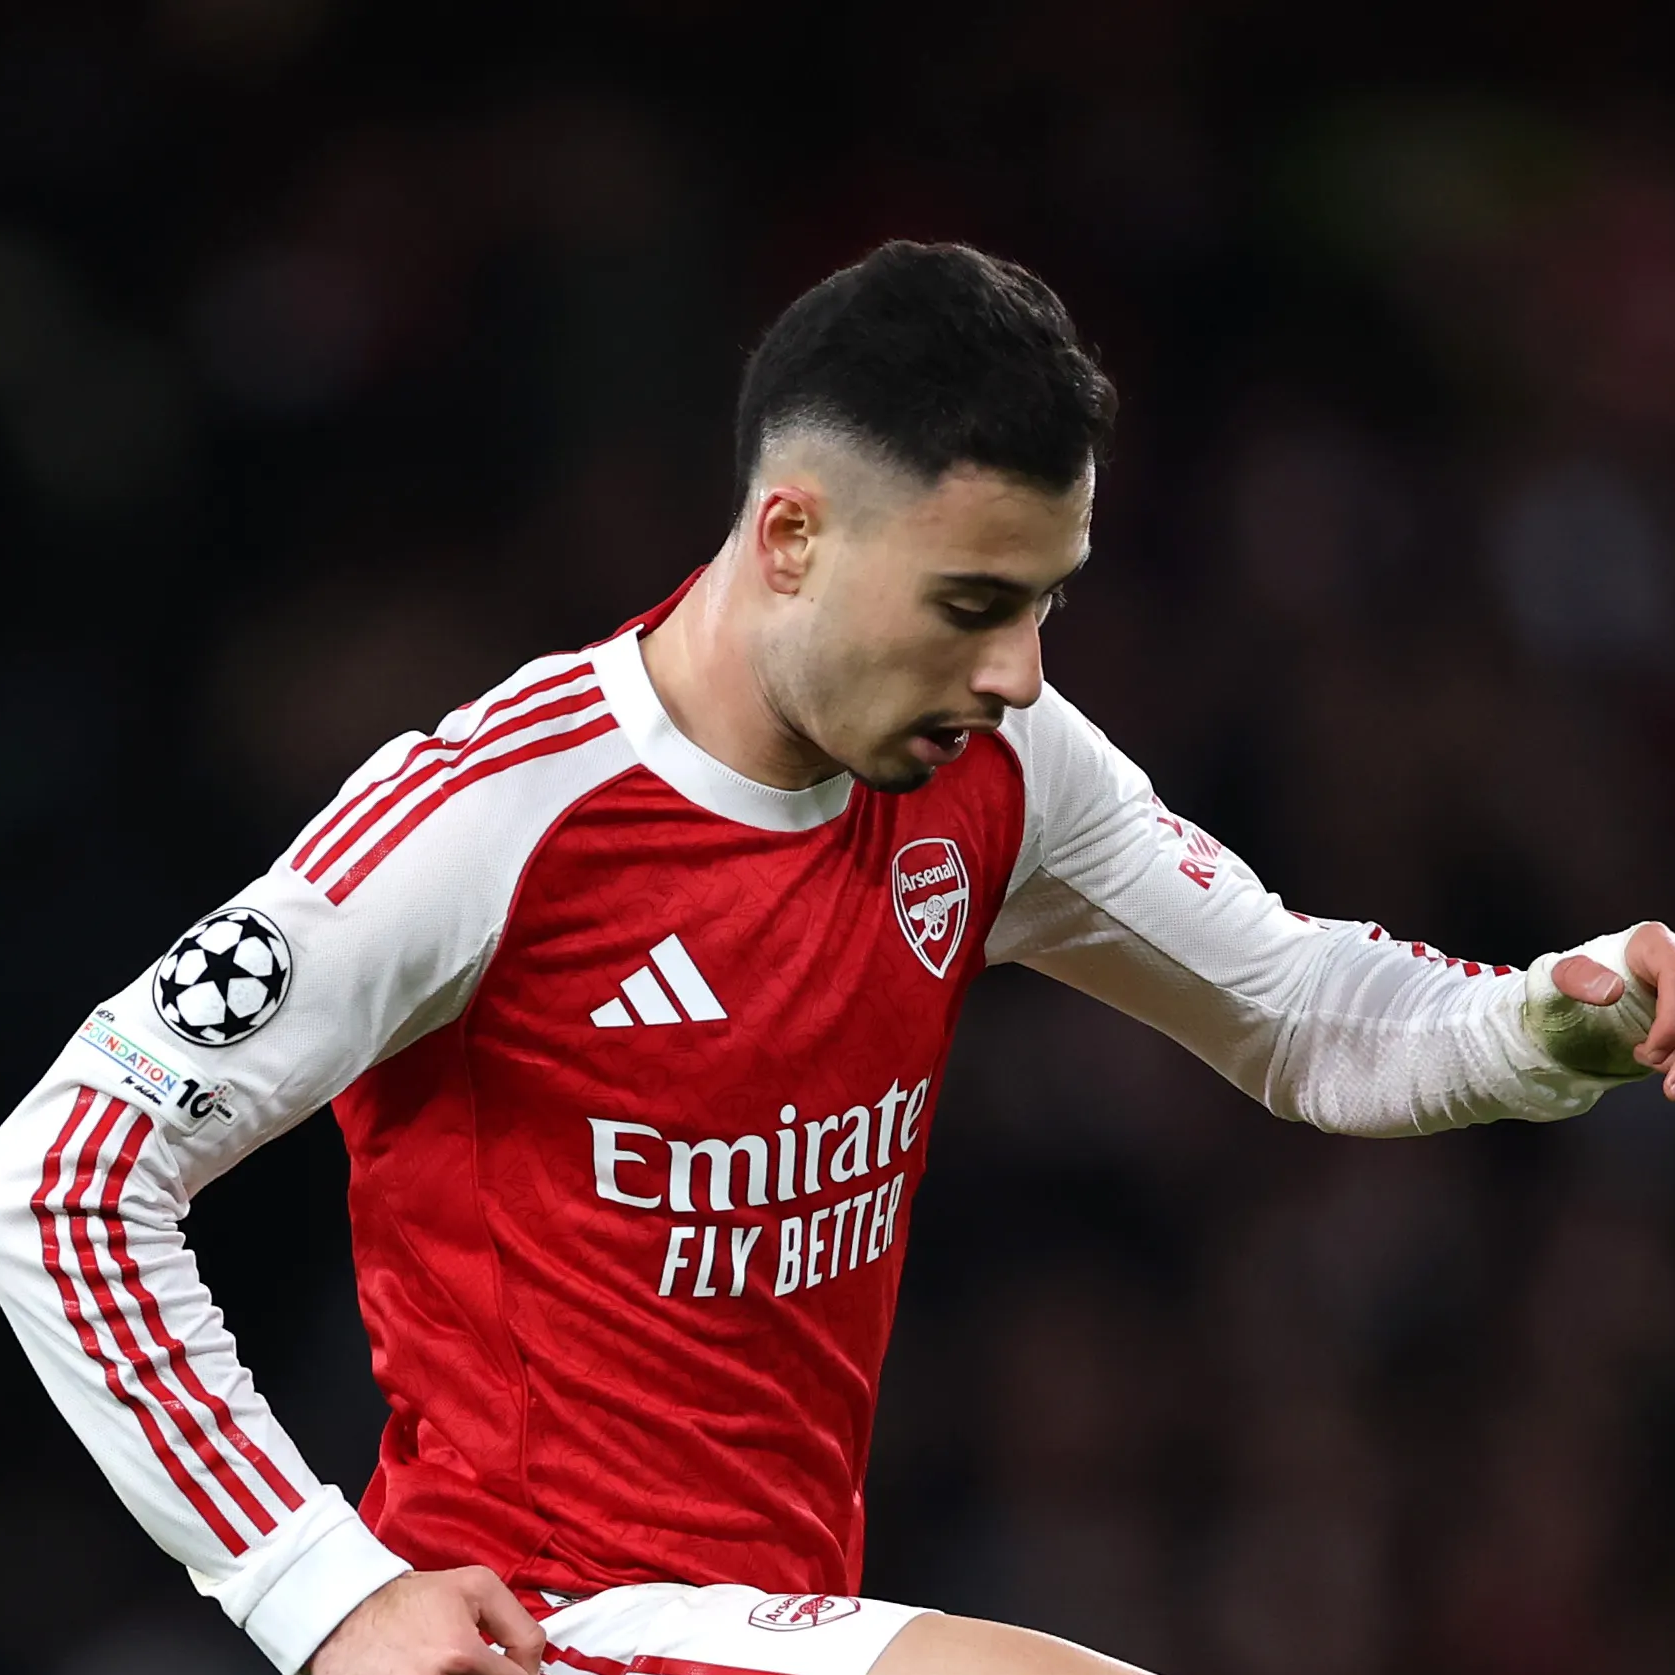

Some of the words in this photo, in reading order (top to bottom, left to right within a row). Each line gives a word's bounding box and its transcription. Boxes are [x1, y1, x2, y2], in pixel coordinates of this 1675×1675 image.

[900, 857, 956, 894] Arsenal
[81, 1021, 177, 1092] FOUNDATION
[586, 1075, 931, 1213] Emirate
[658, 1225, 763, 1298] FLY
[774, 1172, 905, 1298] BETTER
